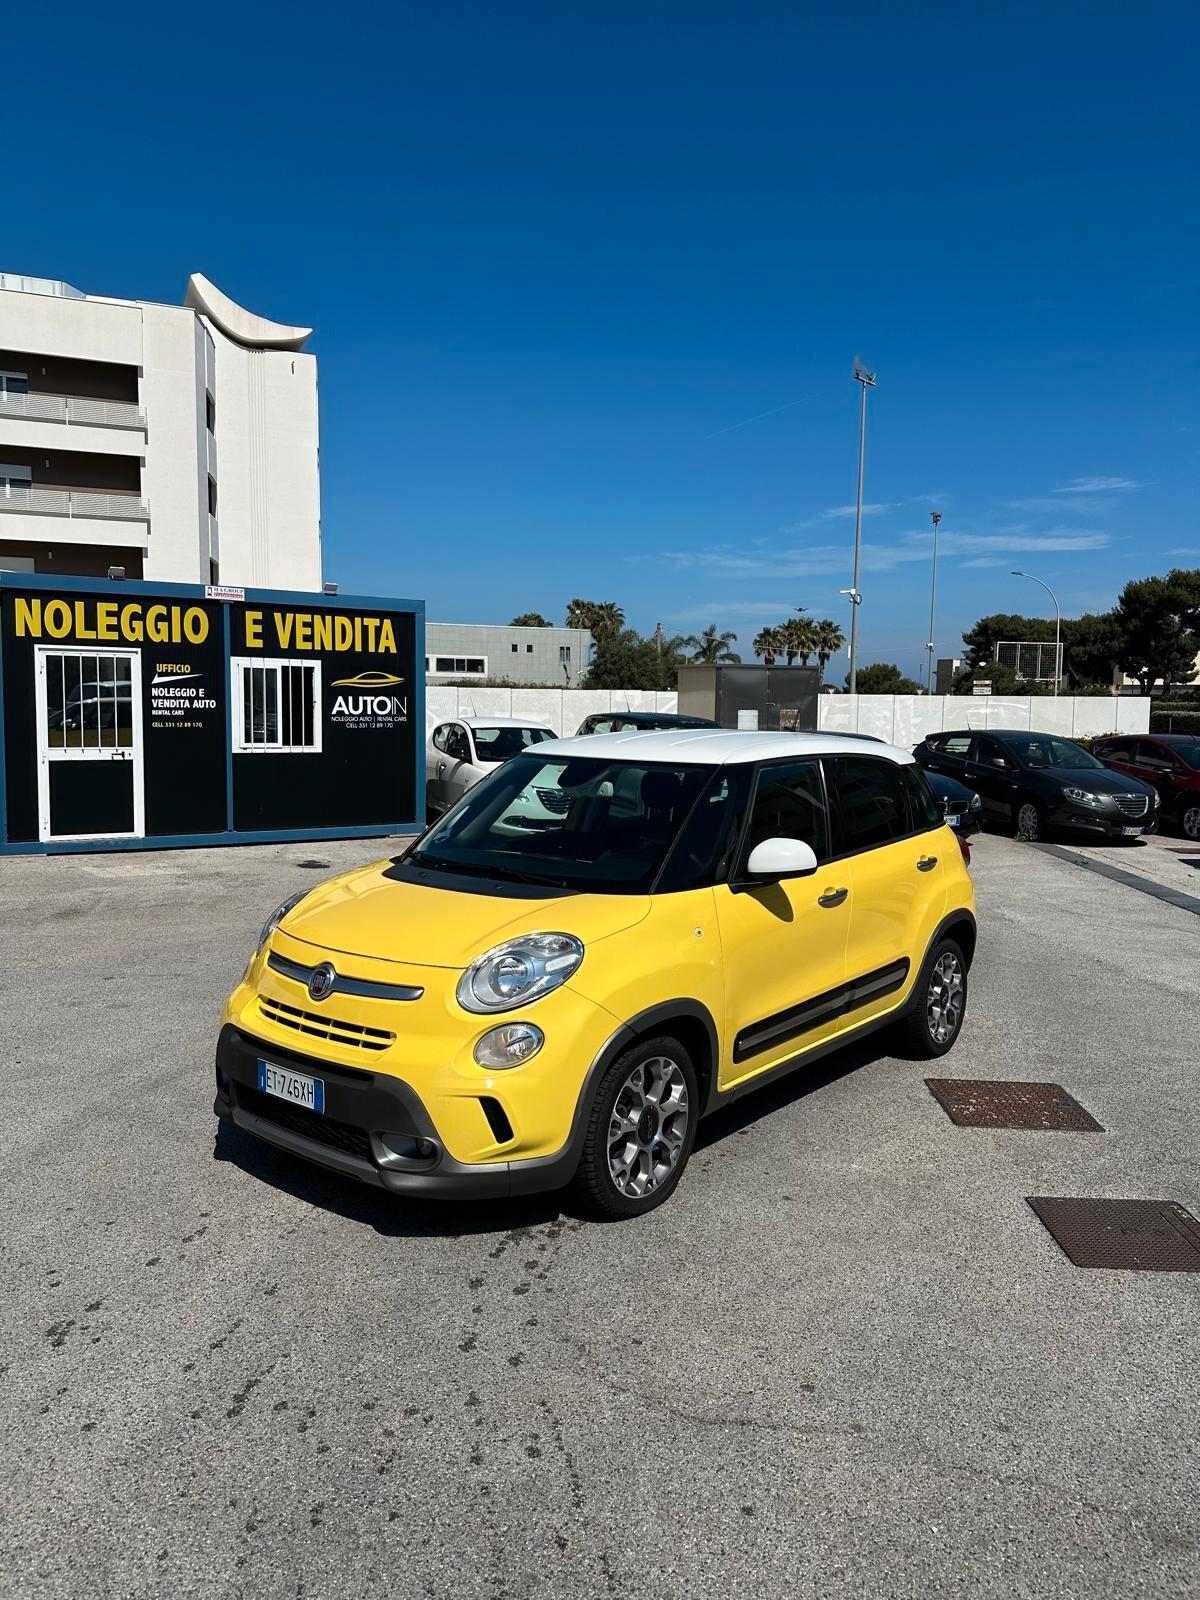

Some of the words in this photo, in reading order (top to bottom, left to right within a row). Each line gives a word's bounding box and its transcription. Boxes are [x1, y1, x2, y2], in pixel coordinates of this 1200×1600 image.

[14, 598, 209, 644] NOLEGGIO
[245, 610, 264, 648] E
[274, 612, 397, 654] VENDITA
[156, 663, 191, 673] UFFICIO
[151, 687, 197, 697] NOLEGGIO
[198, 688, 205, 697] E
[151, 698, 191, 708] VENDITA
[192, 699, 217, 709] AUTO
[331, 695, 407, 715] AUTOIN
